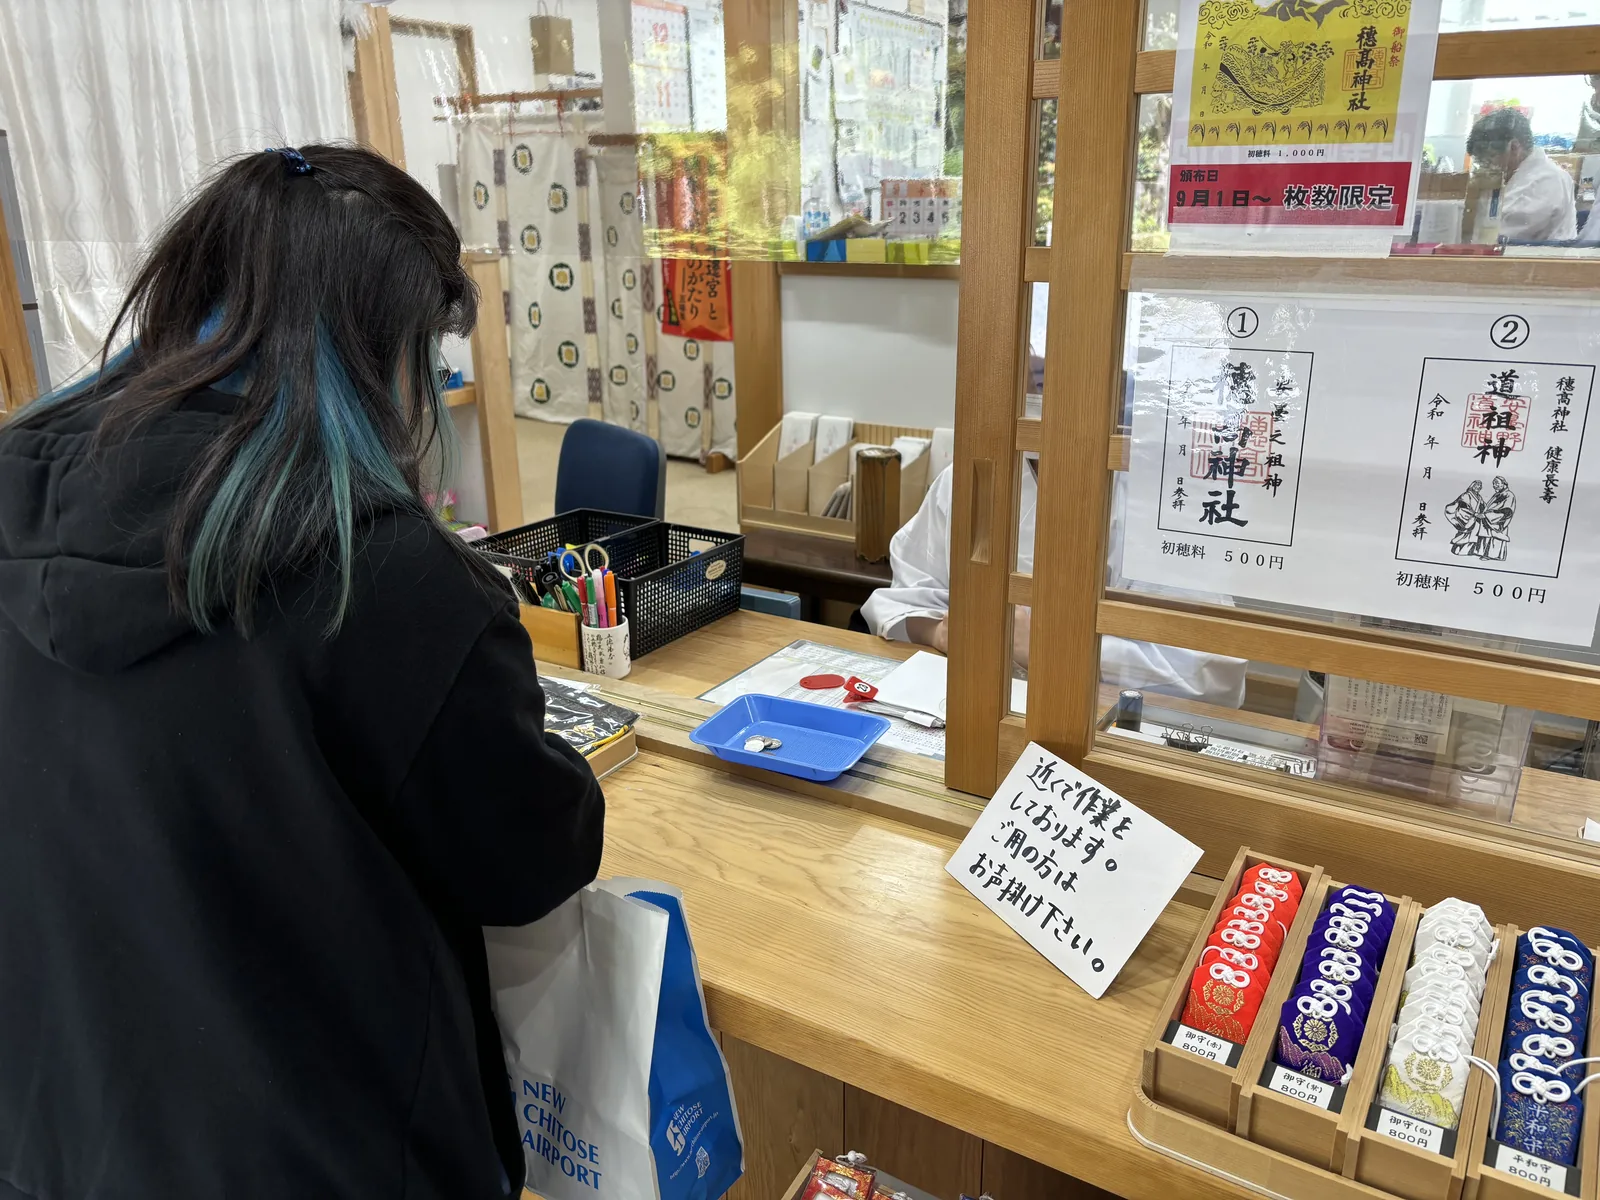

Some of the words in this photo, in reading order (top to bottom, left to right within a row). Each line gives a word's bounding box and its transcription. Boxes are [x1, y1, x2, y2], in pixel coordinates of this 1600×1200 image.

[1388, 26, 1405, 67] 御船祭
[1180, 170, 1219, 182] 頒布日
[1283, 184, 1394, 211] 枚数限定
[1427, 393, 1451, 420] 令和
[1473, 369, 1521, 468] 道祖神
[1178, 444, 1187, 456] 月
[1424, 435, 1439, 450] 年
[1422, 466, 1432, 479] 月
[1412, 502, 1431, 540] 日参拝
[1161, 540, 1205, 559] 初穂料
[1224, 550, 1284, 570] 500円
[1396, 571, 1450, 592] 初穂料
[1473, 582, 1546, 604] 500円
[1027, 757, 1132, 840] 近くで作業を
[1010, 791, 1118, 872] しております。
[991, 820, 1079, 893] ご用の方は
[969, 853, 1105, 972] お声掛け下さい。
[1182, 1043, 1217, 1061] 800円
[523, 1080, 566, 1114] NEW
[1280, 1084, 1317, 1103] 800円
[673, 1104, 684, 1120] NEW
[678, 1101, 702, 1128] CHITOSE
[524, 1104, 600, 1164] CHITOSE
[1388, 1128, 1428, 1148] 800円
[1523, 1104, 1549, 1154] 平和守
[522, 1129, 602, 1190] AIRPORT
[1512, 1154, 1552, 1174] 平和守
[1508, 1165, 1551, 1188] 800円
